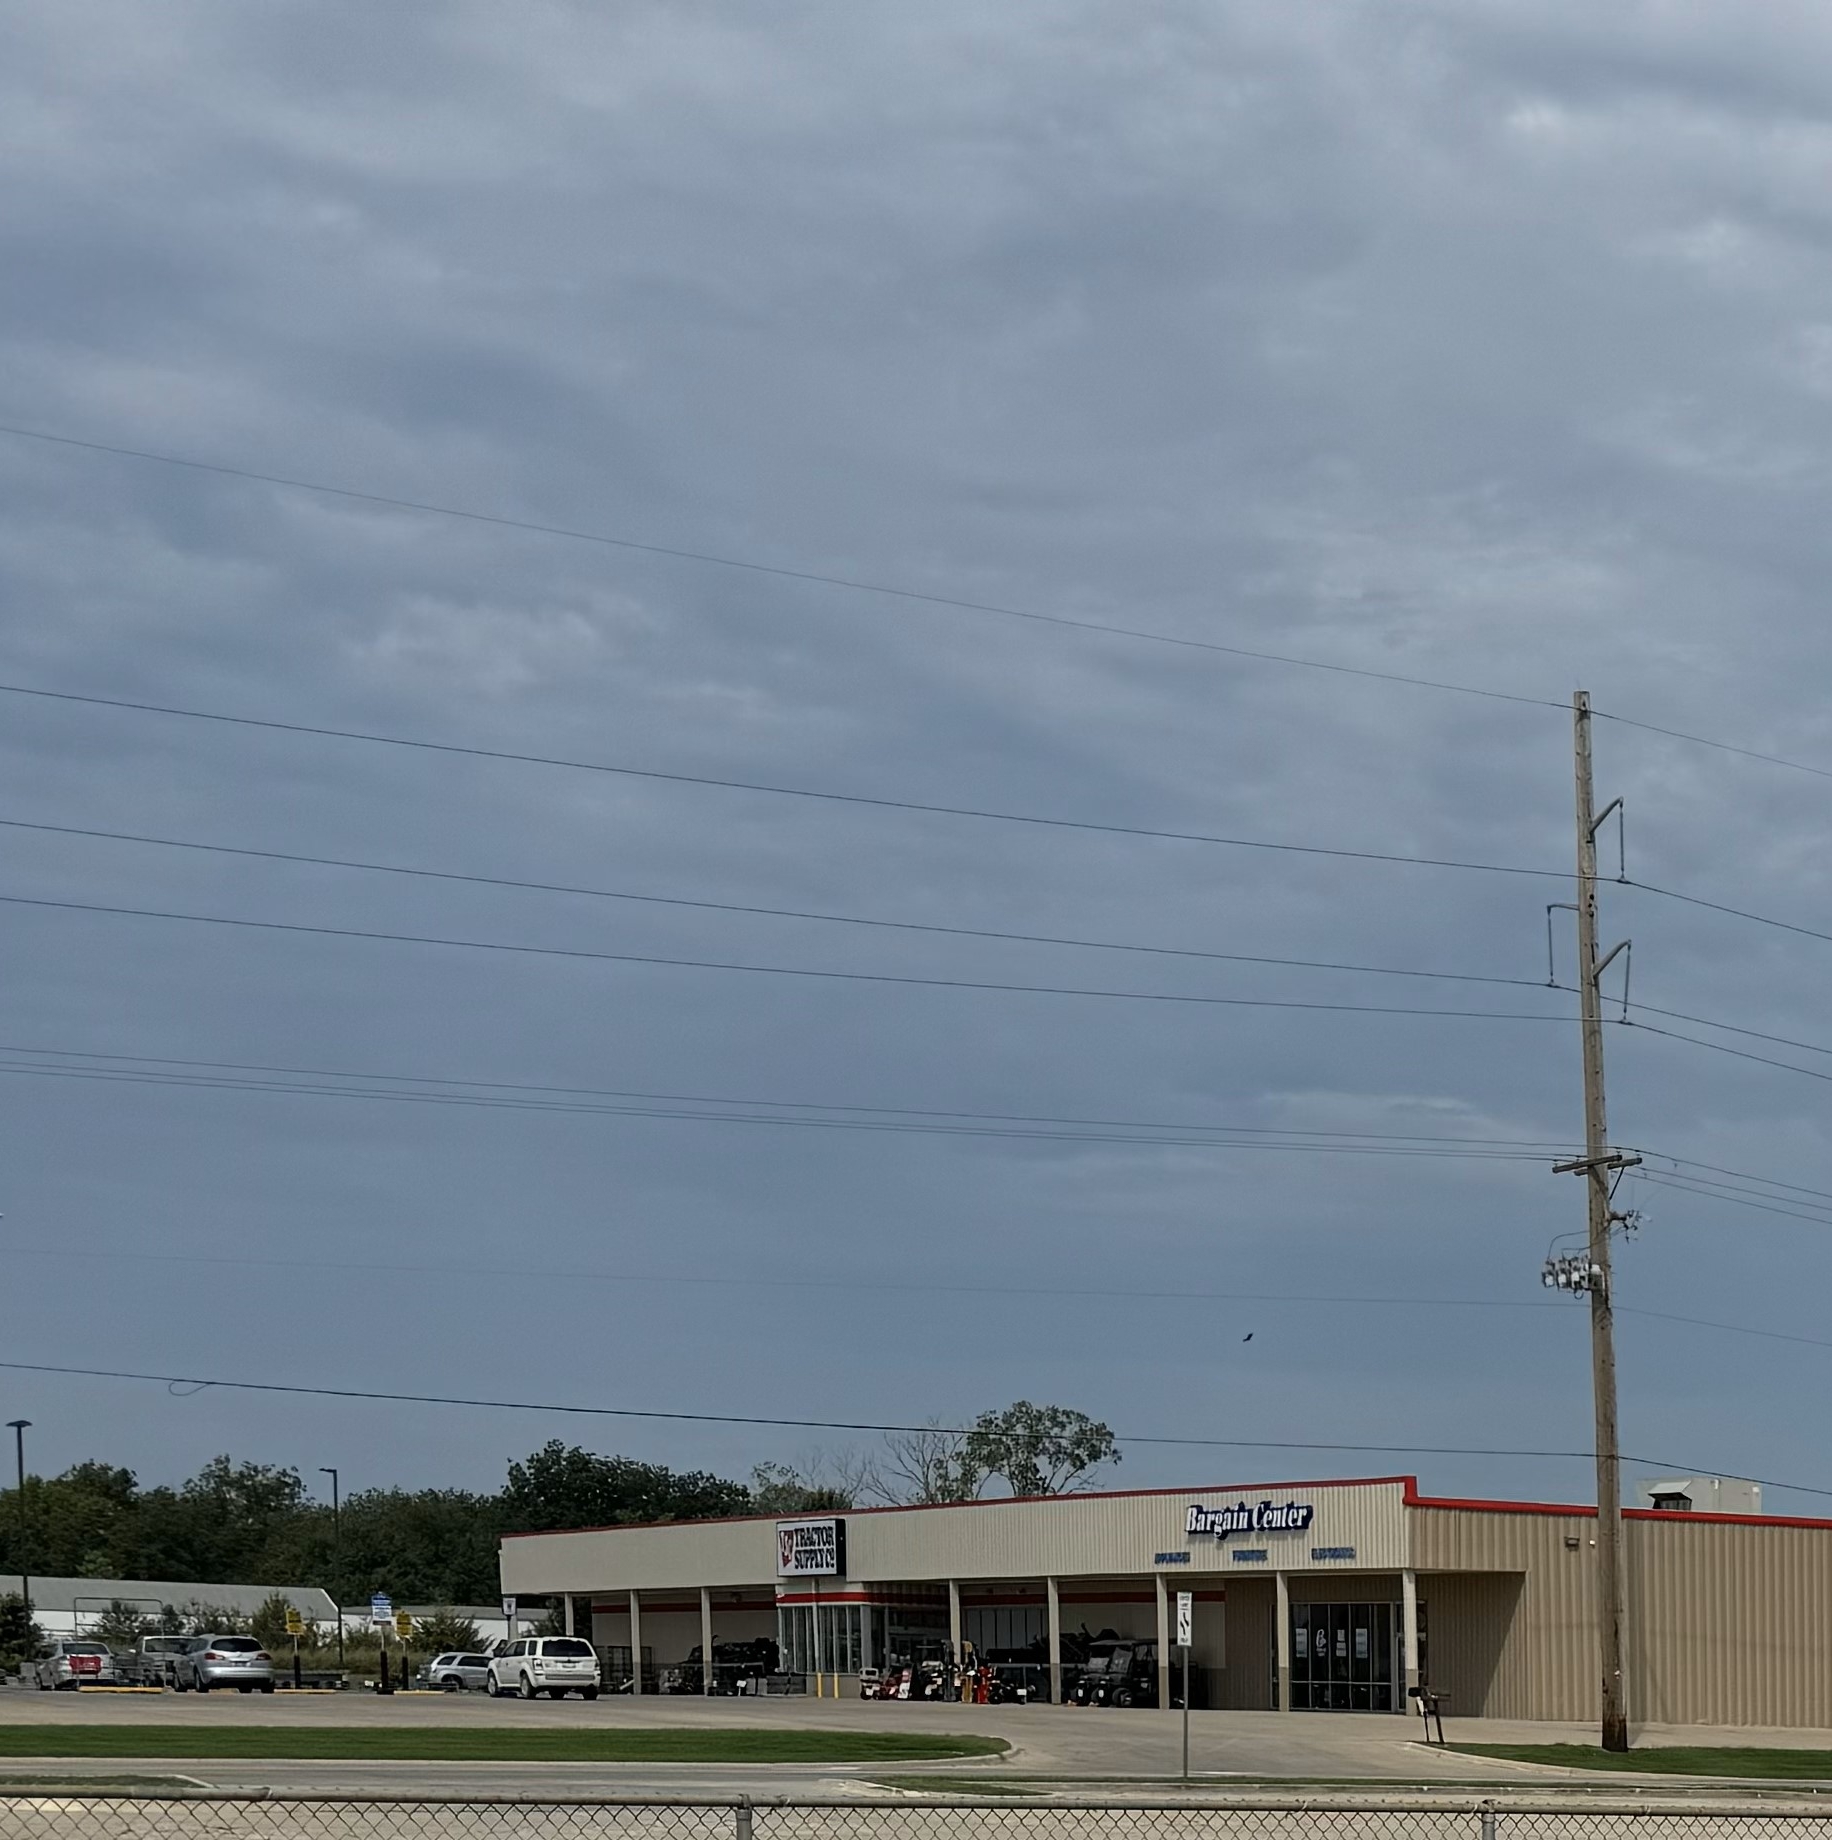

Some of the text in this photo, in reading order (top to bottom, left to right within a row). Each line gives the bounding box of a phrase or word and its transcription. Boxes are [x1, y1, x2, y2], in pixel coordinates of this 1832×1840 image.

[1185, 1502, 1310, 1539] Bargain Center
[794, 1526, 834, 1548] TRACTOR
[794, 1549, 824, 1569] SUPPLY
